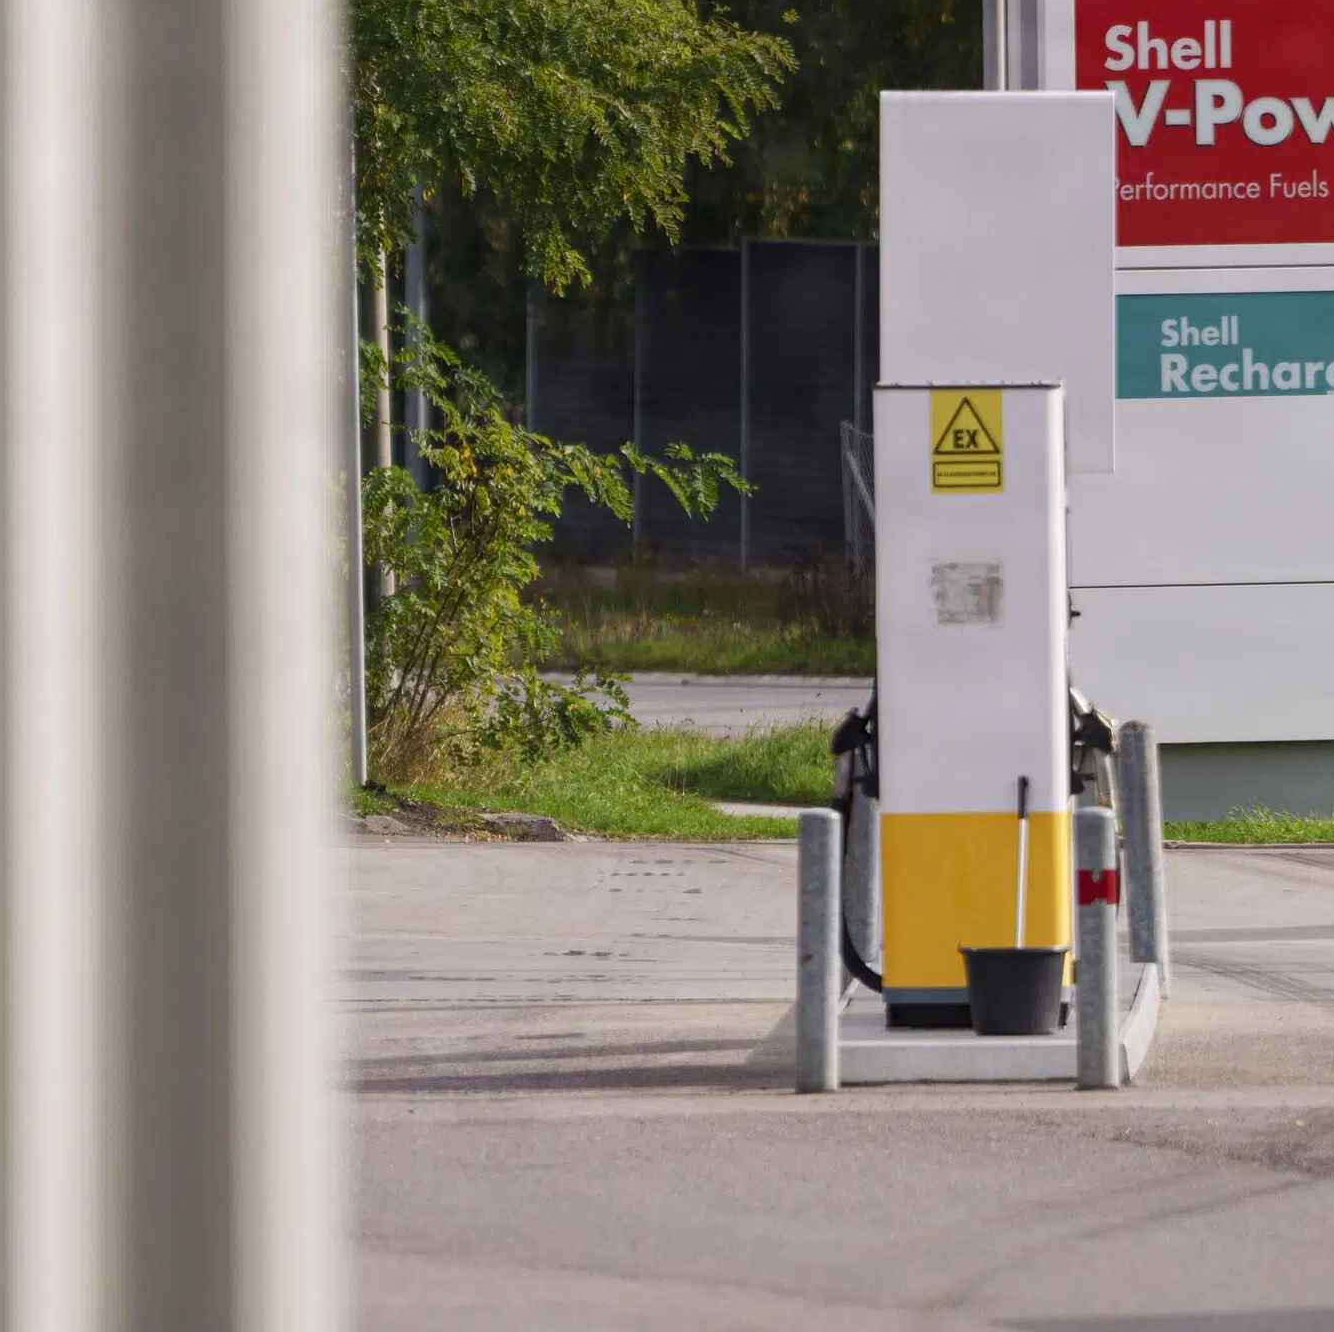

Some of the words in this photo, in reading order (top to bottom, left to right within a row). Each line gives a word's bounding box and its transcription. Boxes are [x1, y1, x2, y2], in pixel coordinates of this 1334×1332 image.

[1104, 19, 1233, 72] Shell
[1269, 169, 1330, 199] Fuels
[1160, 315, 1240, 348] Shell
[952, 429, 979, 449] EX
